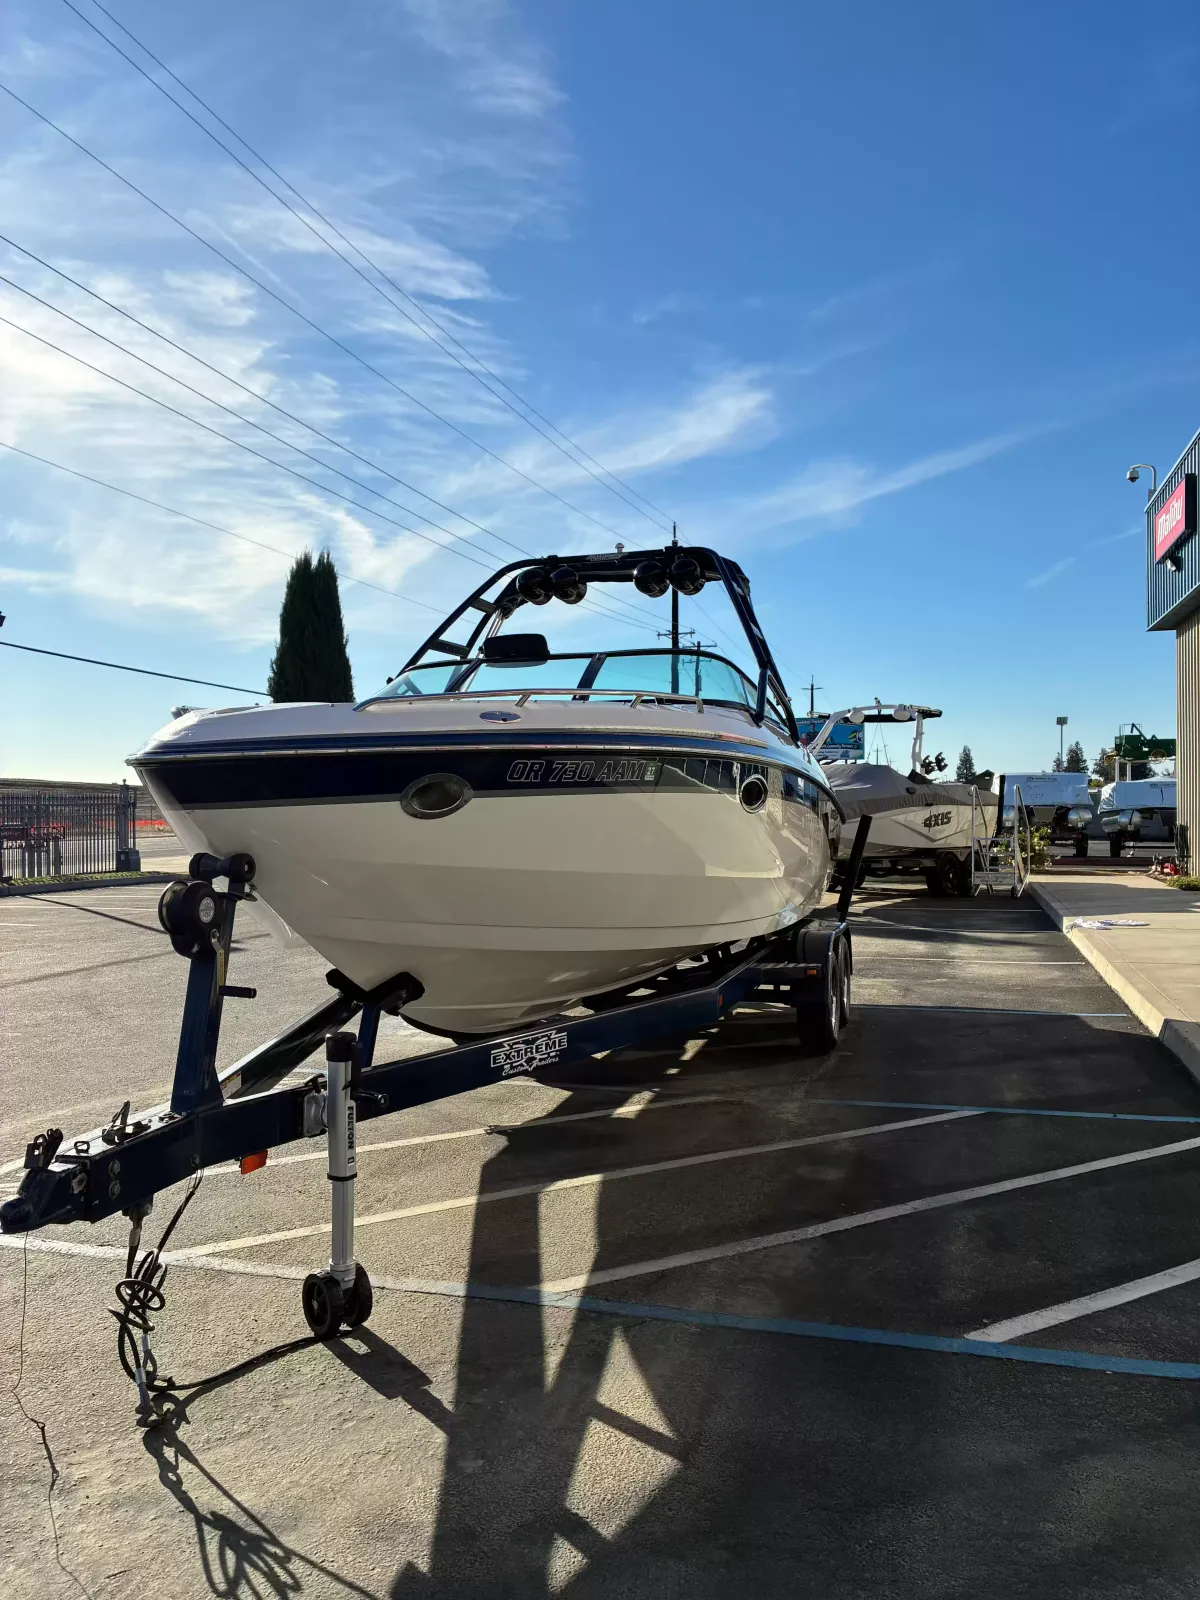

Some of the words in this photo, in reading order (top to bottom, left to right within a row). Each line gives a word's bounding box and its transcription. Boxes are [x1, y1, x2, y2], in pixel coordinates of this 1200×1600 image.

[1157, 496, 1183, 545] Malibu
[507, 760, 546, 782] OR
[549, 760, 596, 782] 730
[595, 760, 646, 781] AAM
[646, 766, 656, 775] 27
[490, 1035, 568, 1068] EXTREME
[502, 1064, 530, 1076] Custom
[347, 1105, 355, 1150] FULTON
